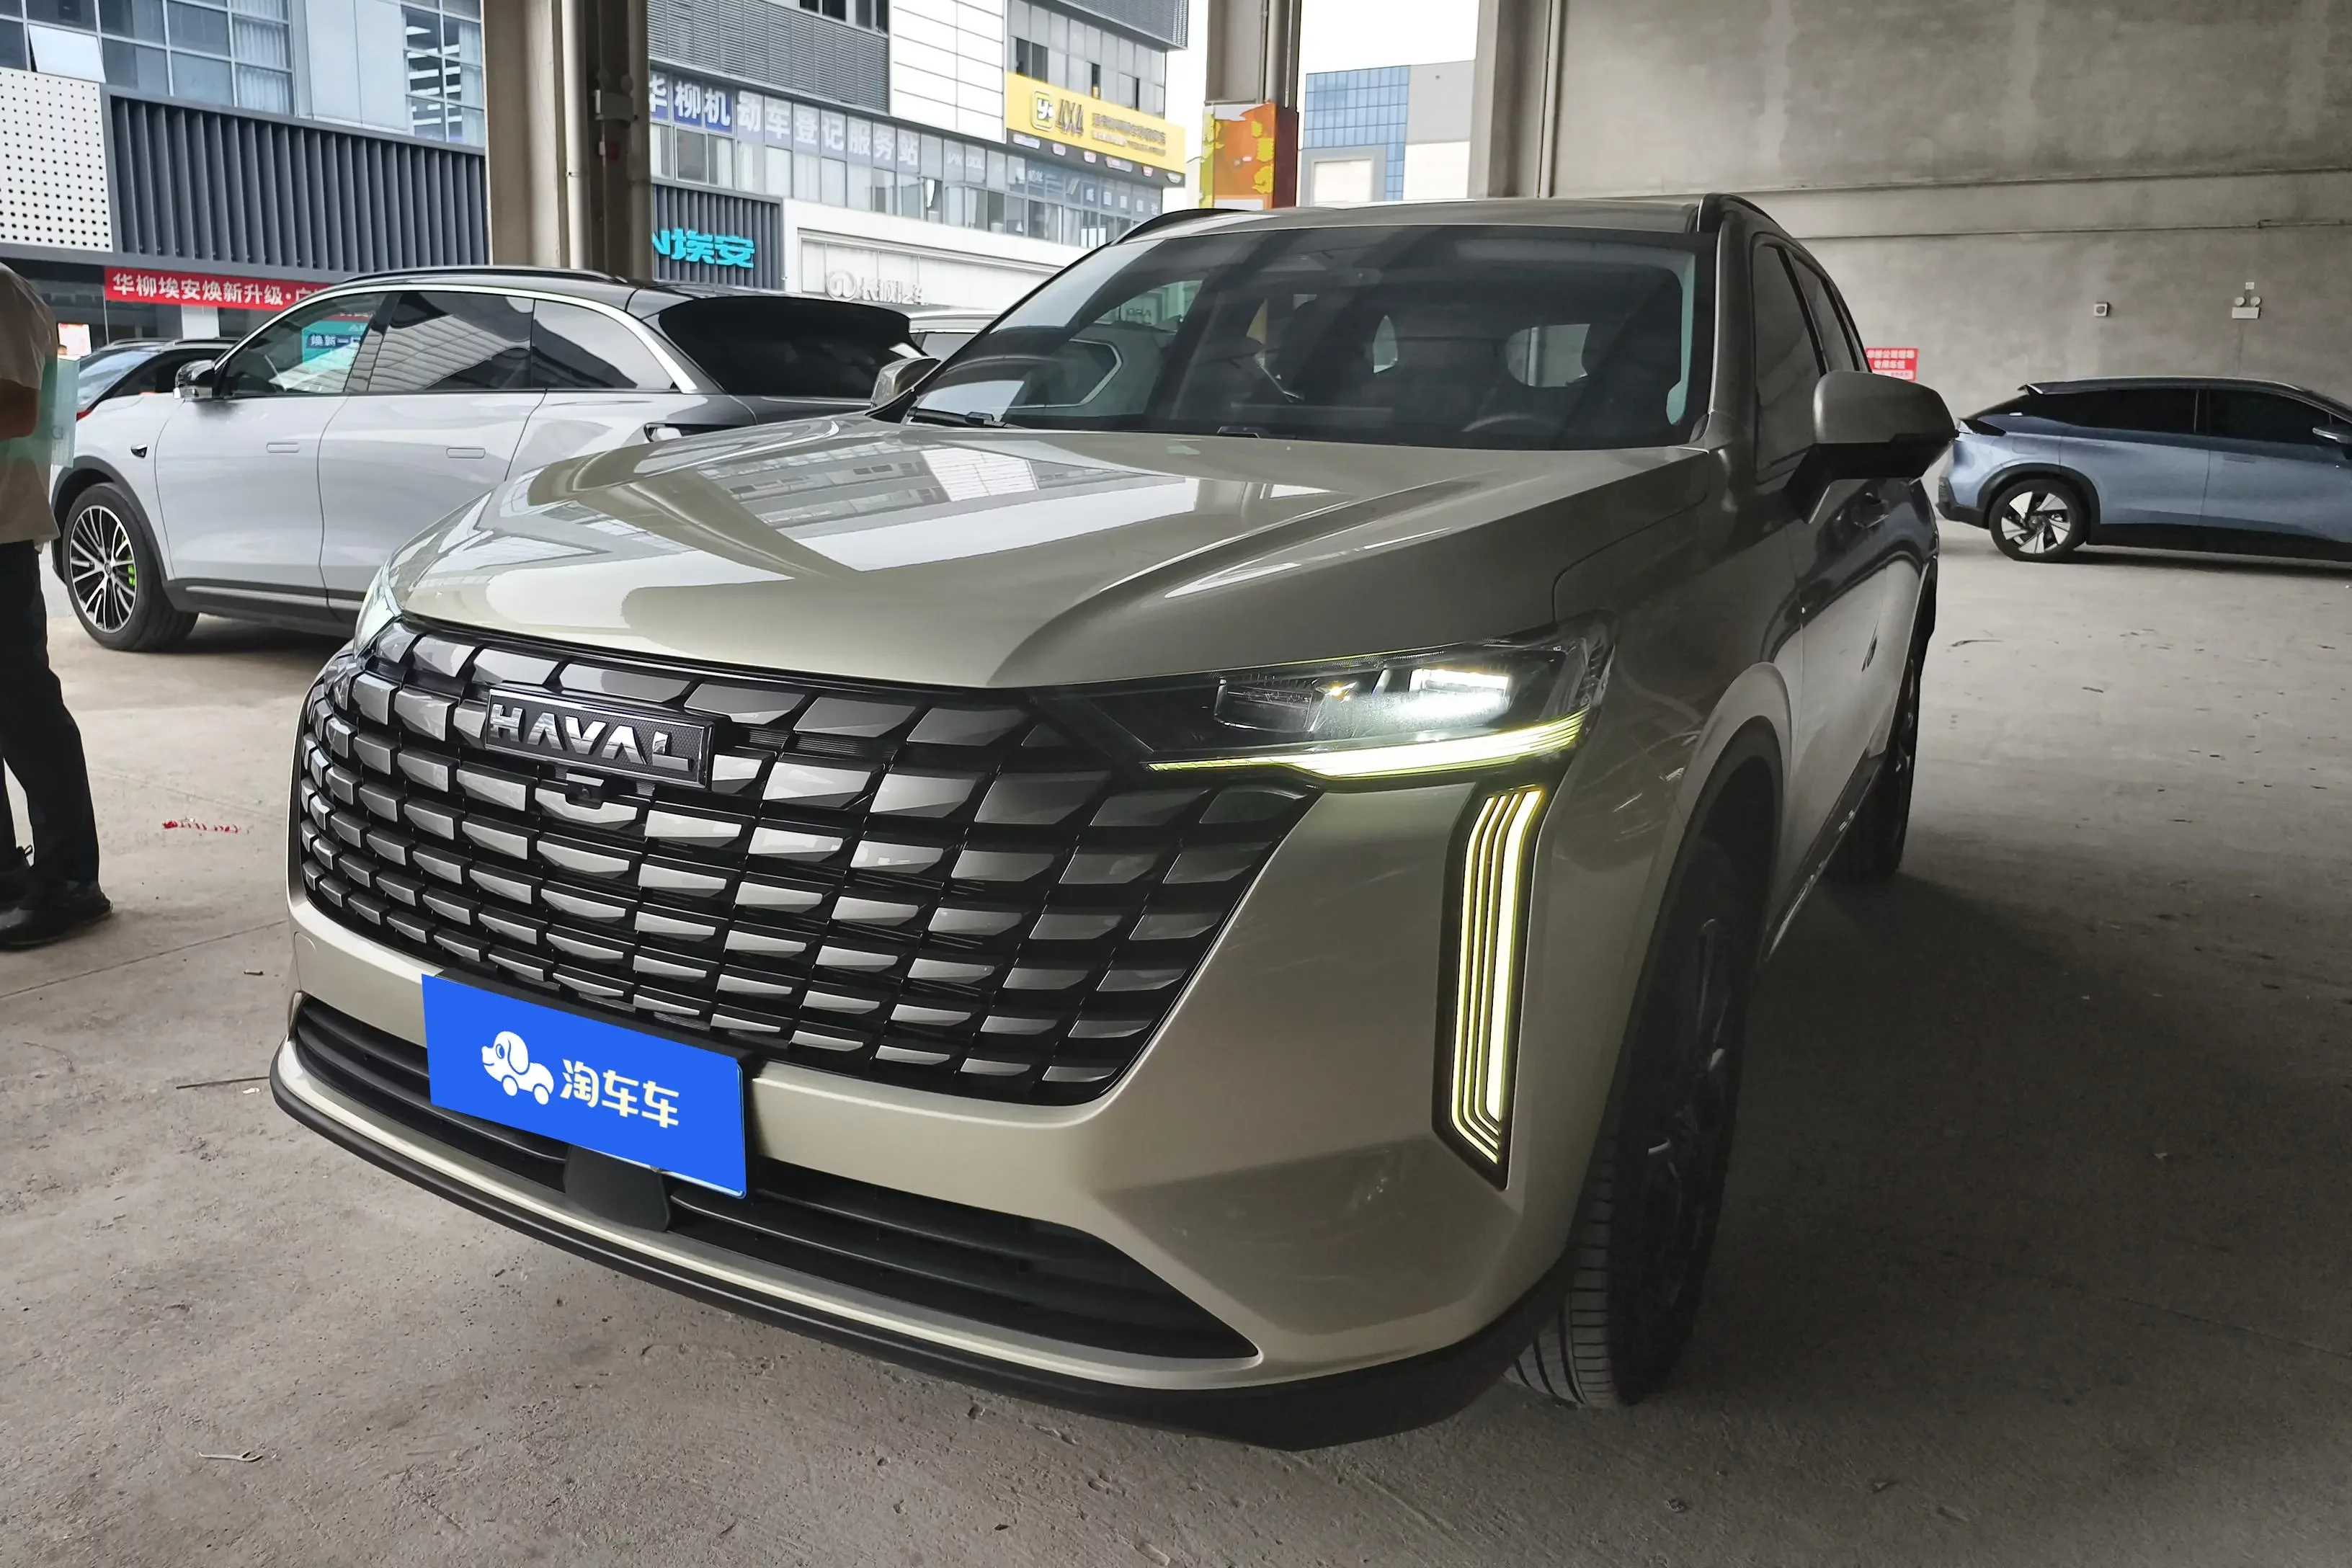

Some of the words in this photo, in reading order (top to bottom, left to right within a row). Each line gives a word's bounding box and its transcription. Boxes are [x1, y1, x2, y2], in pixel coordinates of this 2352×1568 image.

[112, 272, 316, 306] 华柳埃安焕新升级·广
[490, 703, 690, 772] HAVAL
